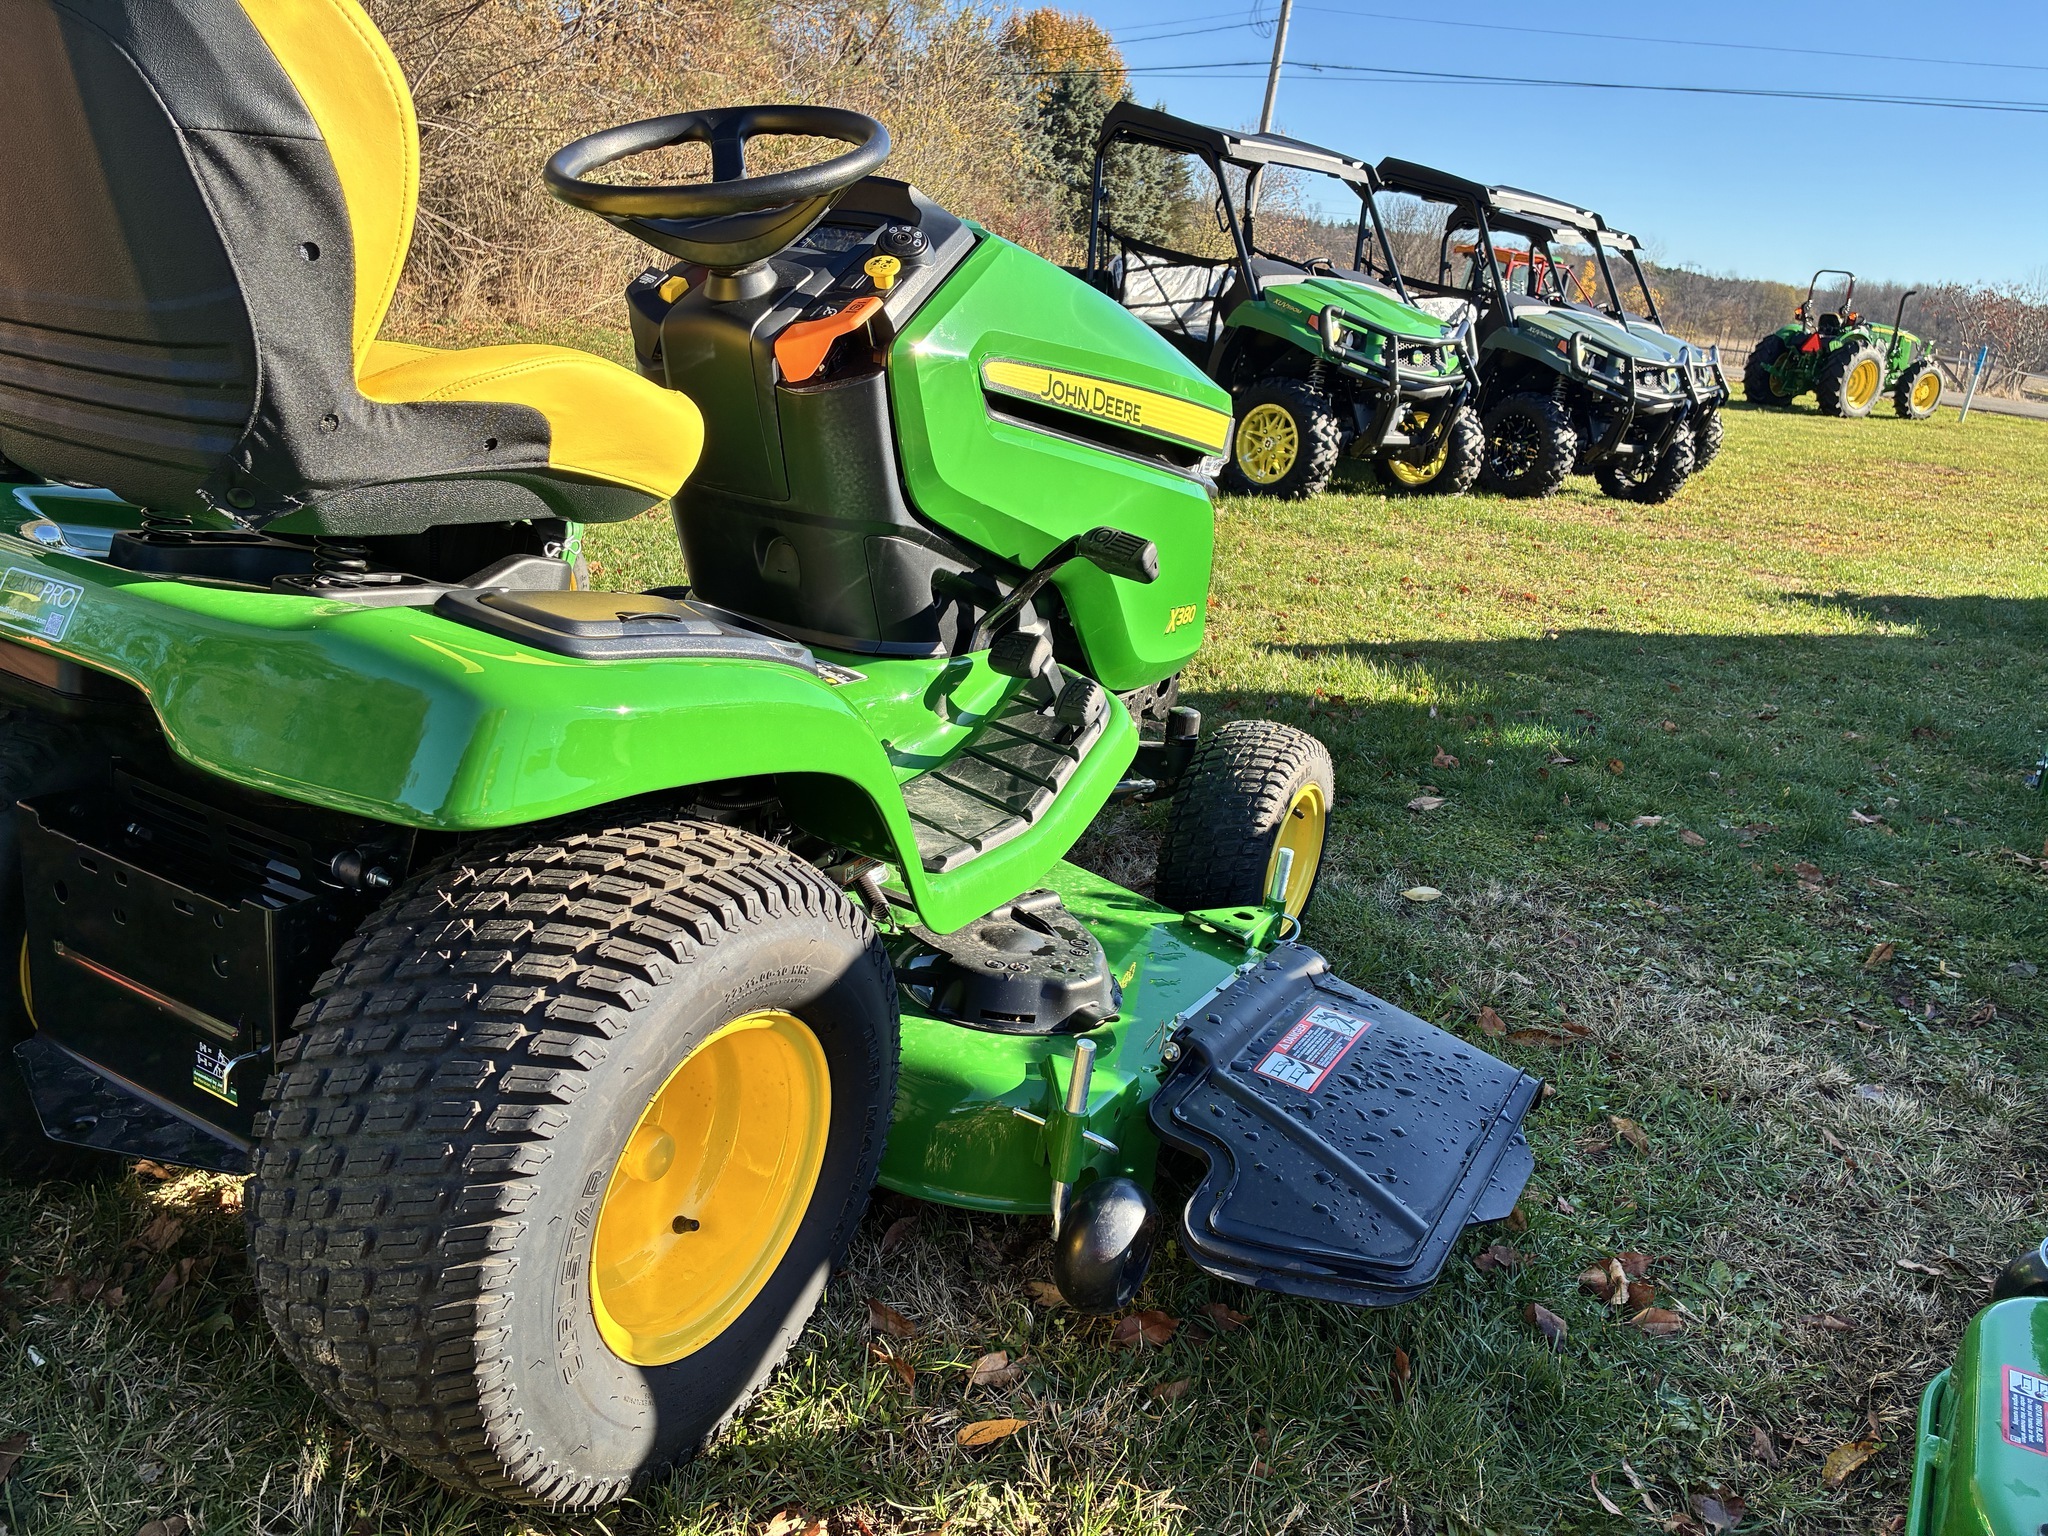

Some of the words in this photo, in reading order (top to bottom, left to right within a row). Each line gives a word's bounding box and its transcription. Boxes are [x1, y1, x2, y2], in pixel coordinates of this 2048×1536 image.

[1040, 374, 1090, 408] JOHN
[1092, 388, 1142, 424] DEERE
[1164, 604, 1197, 635] X380
[862, 1021, 882, 1100] TURF
[1284, 1024, 1308, 1047] DANGER
[828, 1103, 880, 1246] MASTER
[556, 1168, 608, 1385] CARLSTAR
